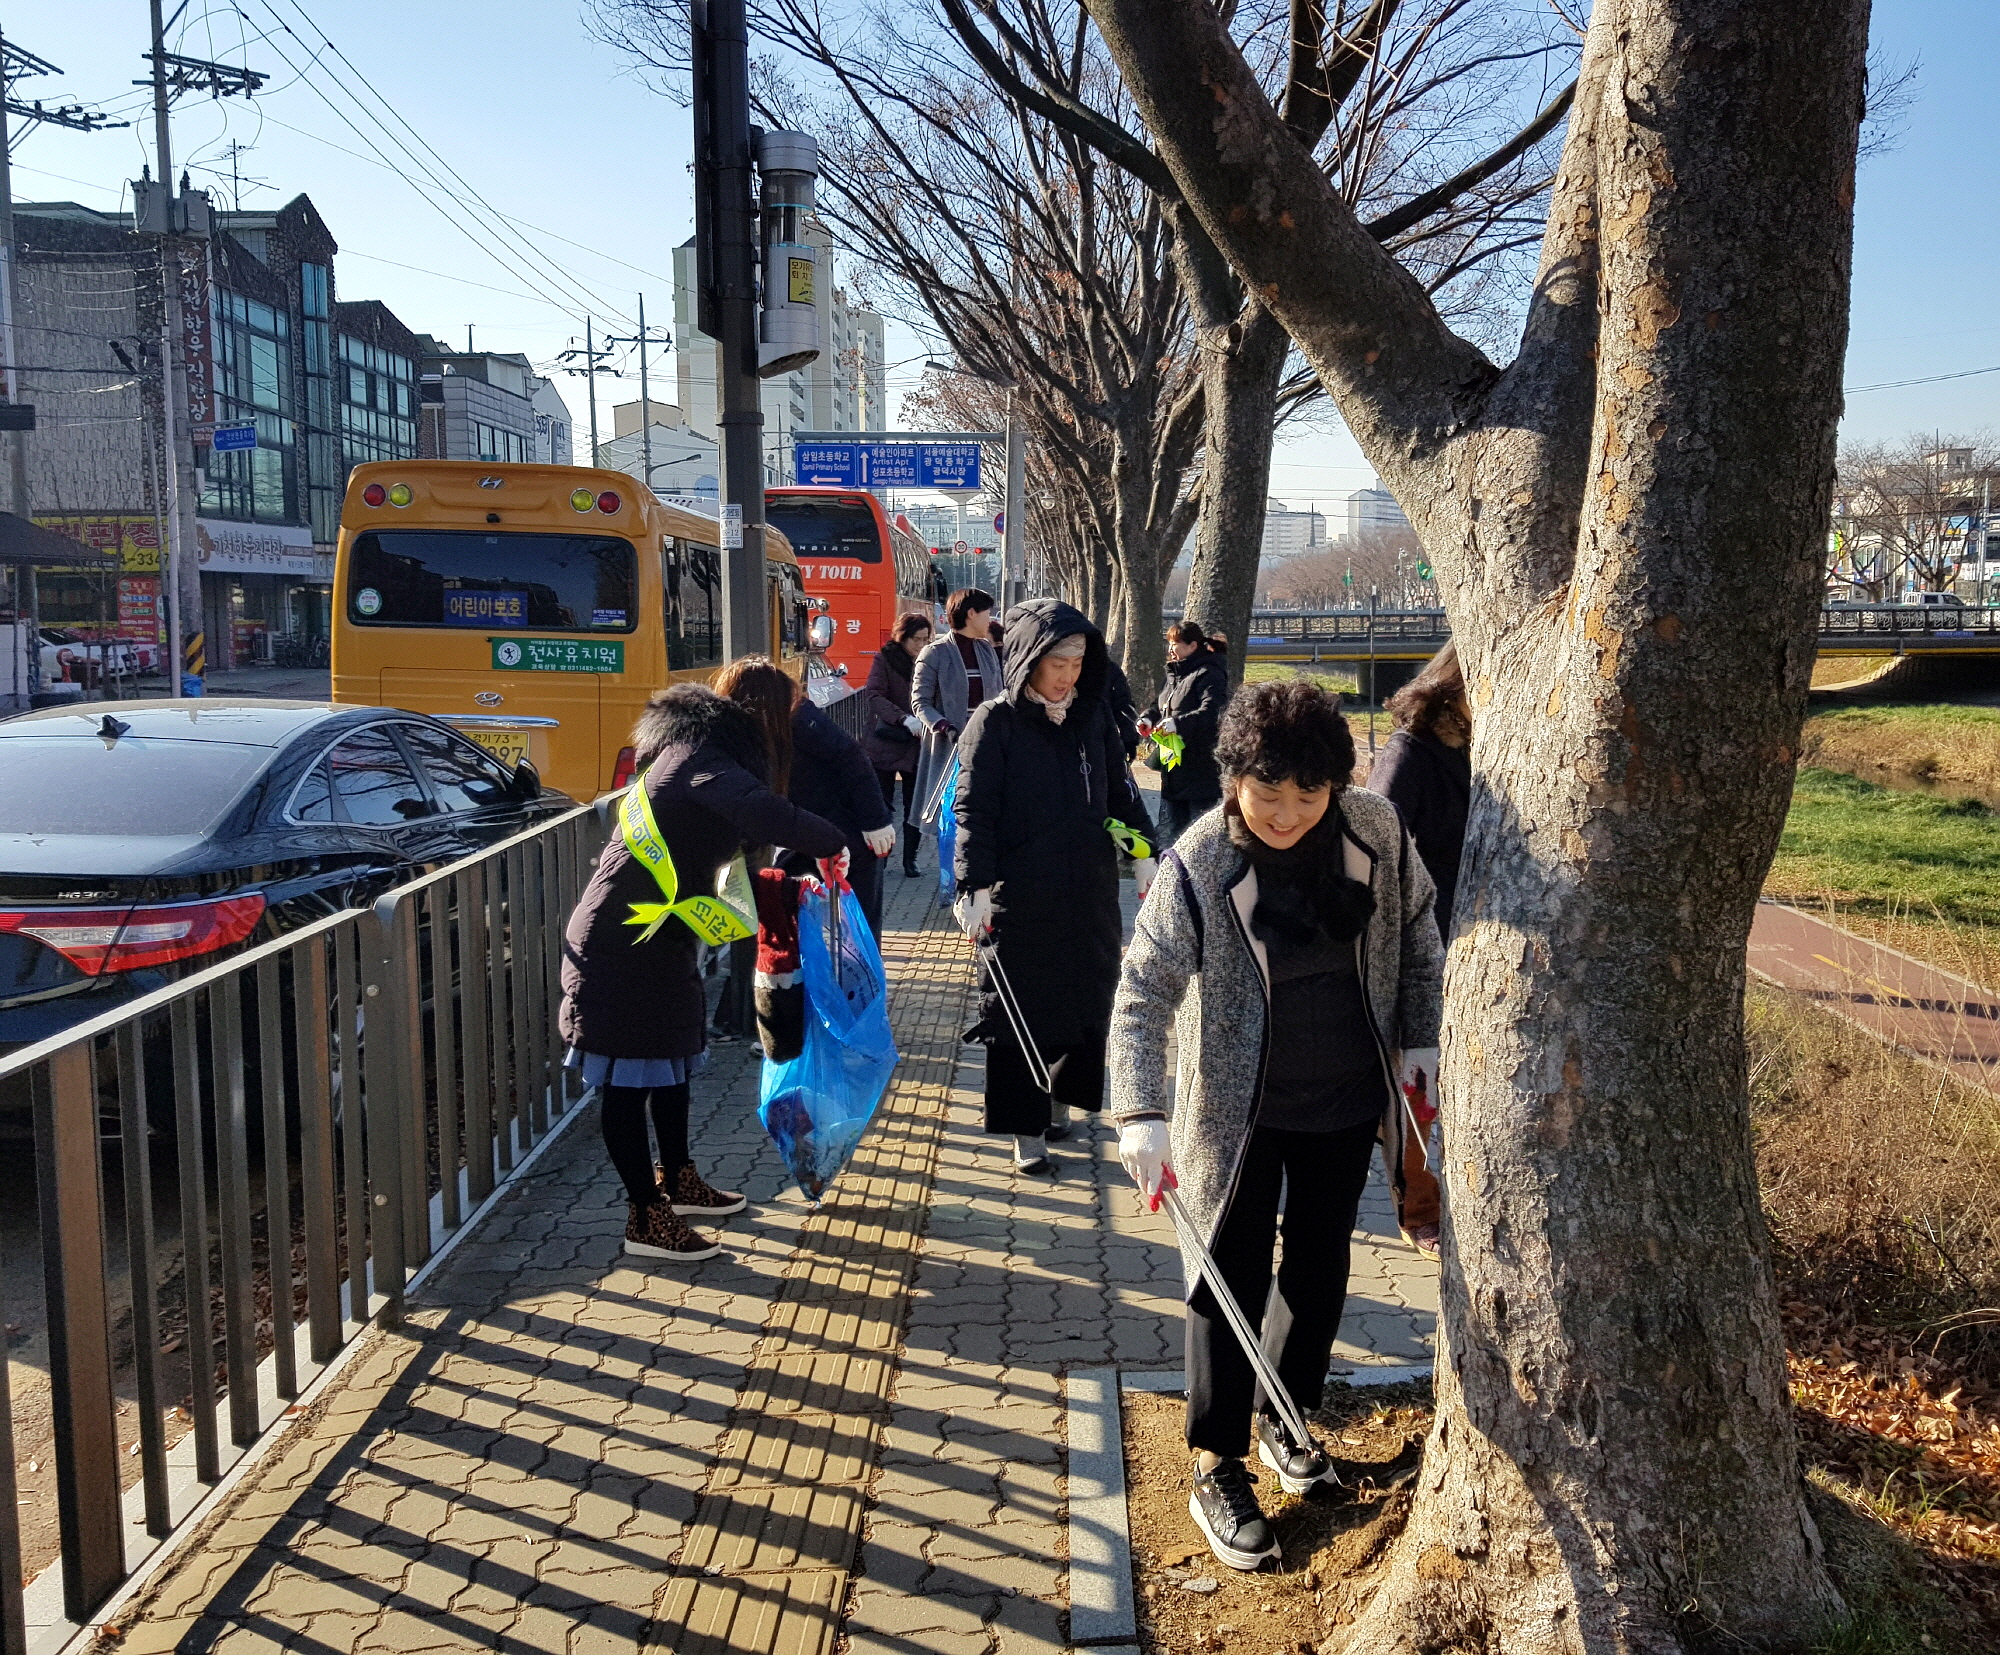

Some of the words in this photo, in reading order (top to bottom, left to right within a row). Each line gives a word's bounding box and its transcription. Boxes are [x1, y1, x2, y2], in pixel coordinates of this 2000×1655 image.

[802, 451, 850, 462] 삼일초등학교
[872, 447, 915, 458] 예술인아파트
[924, 447, 975, 457] 서울예술대학교
[802, 463, 815, 471] Samil
[816, 463, 833, 472] Primary
[834, 463, 851, 471] School
[895, 459, 910, 467] Apt
[872, 467, 915, 477] 성포초등학교
[933, 466, 966, 476] 광덕시장
[819, 565, 863, 580] TOUR
[450, 597, 522, 618] 어린이보호
[531, 663, 557, 671] 교육상담
